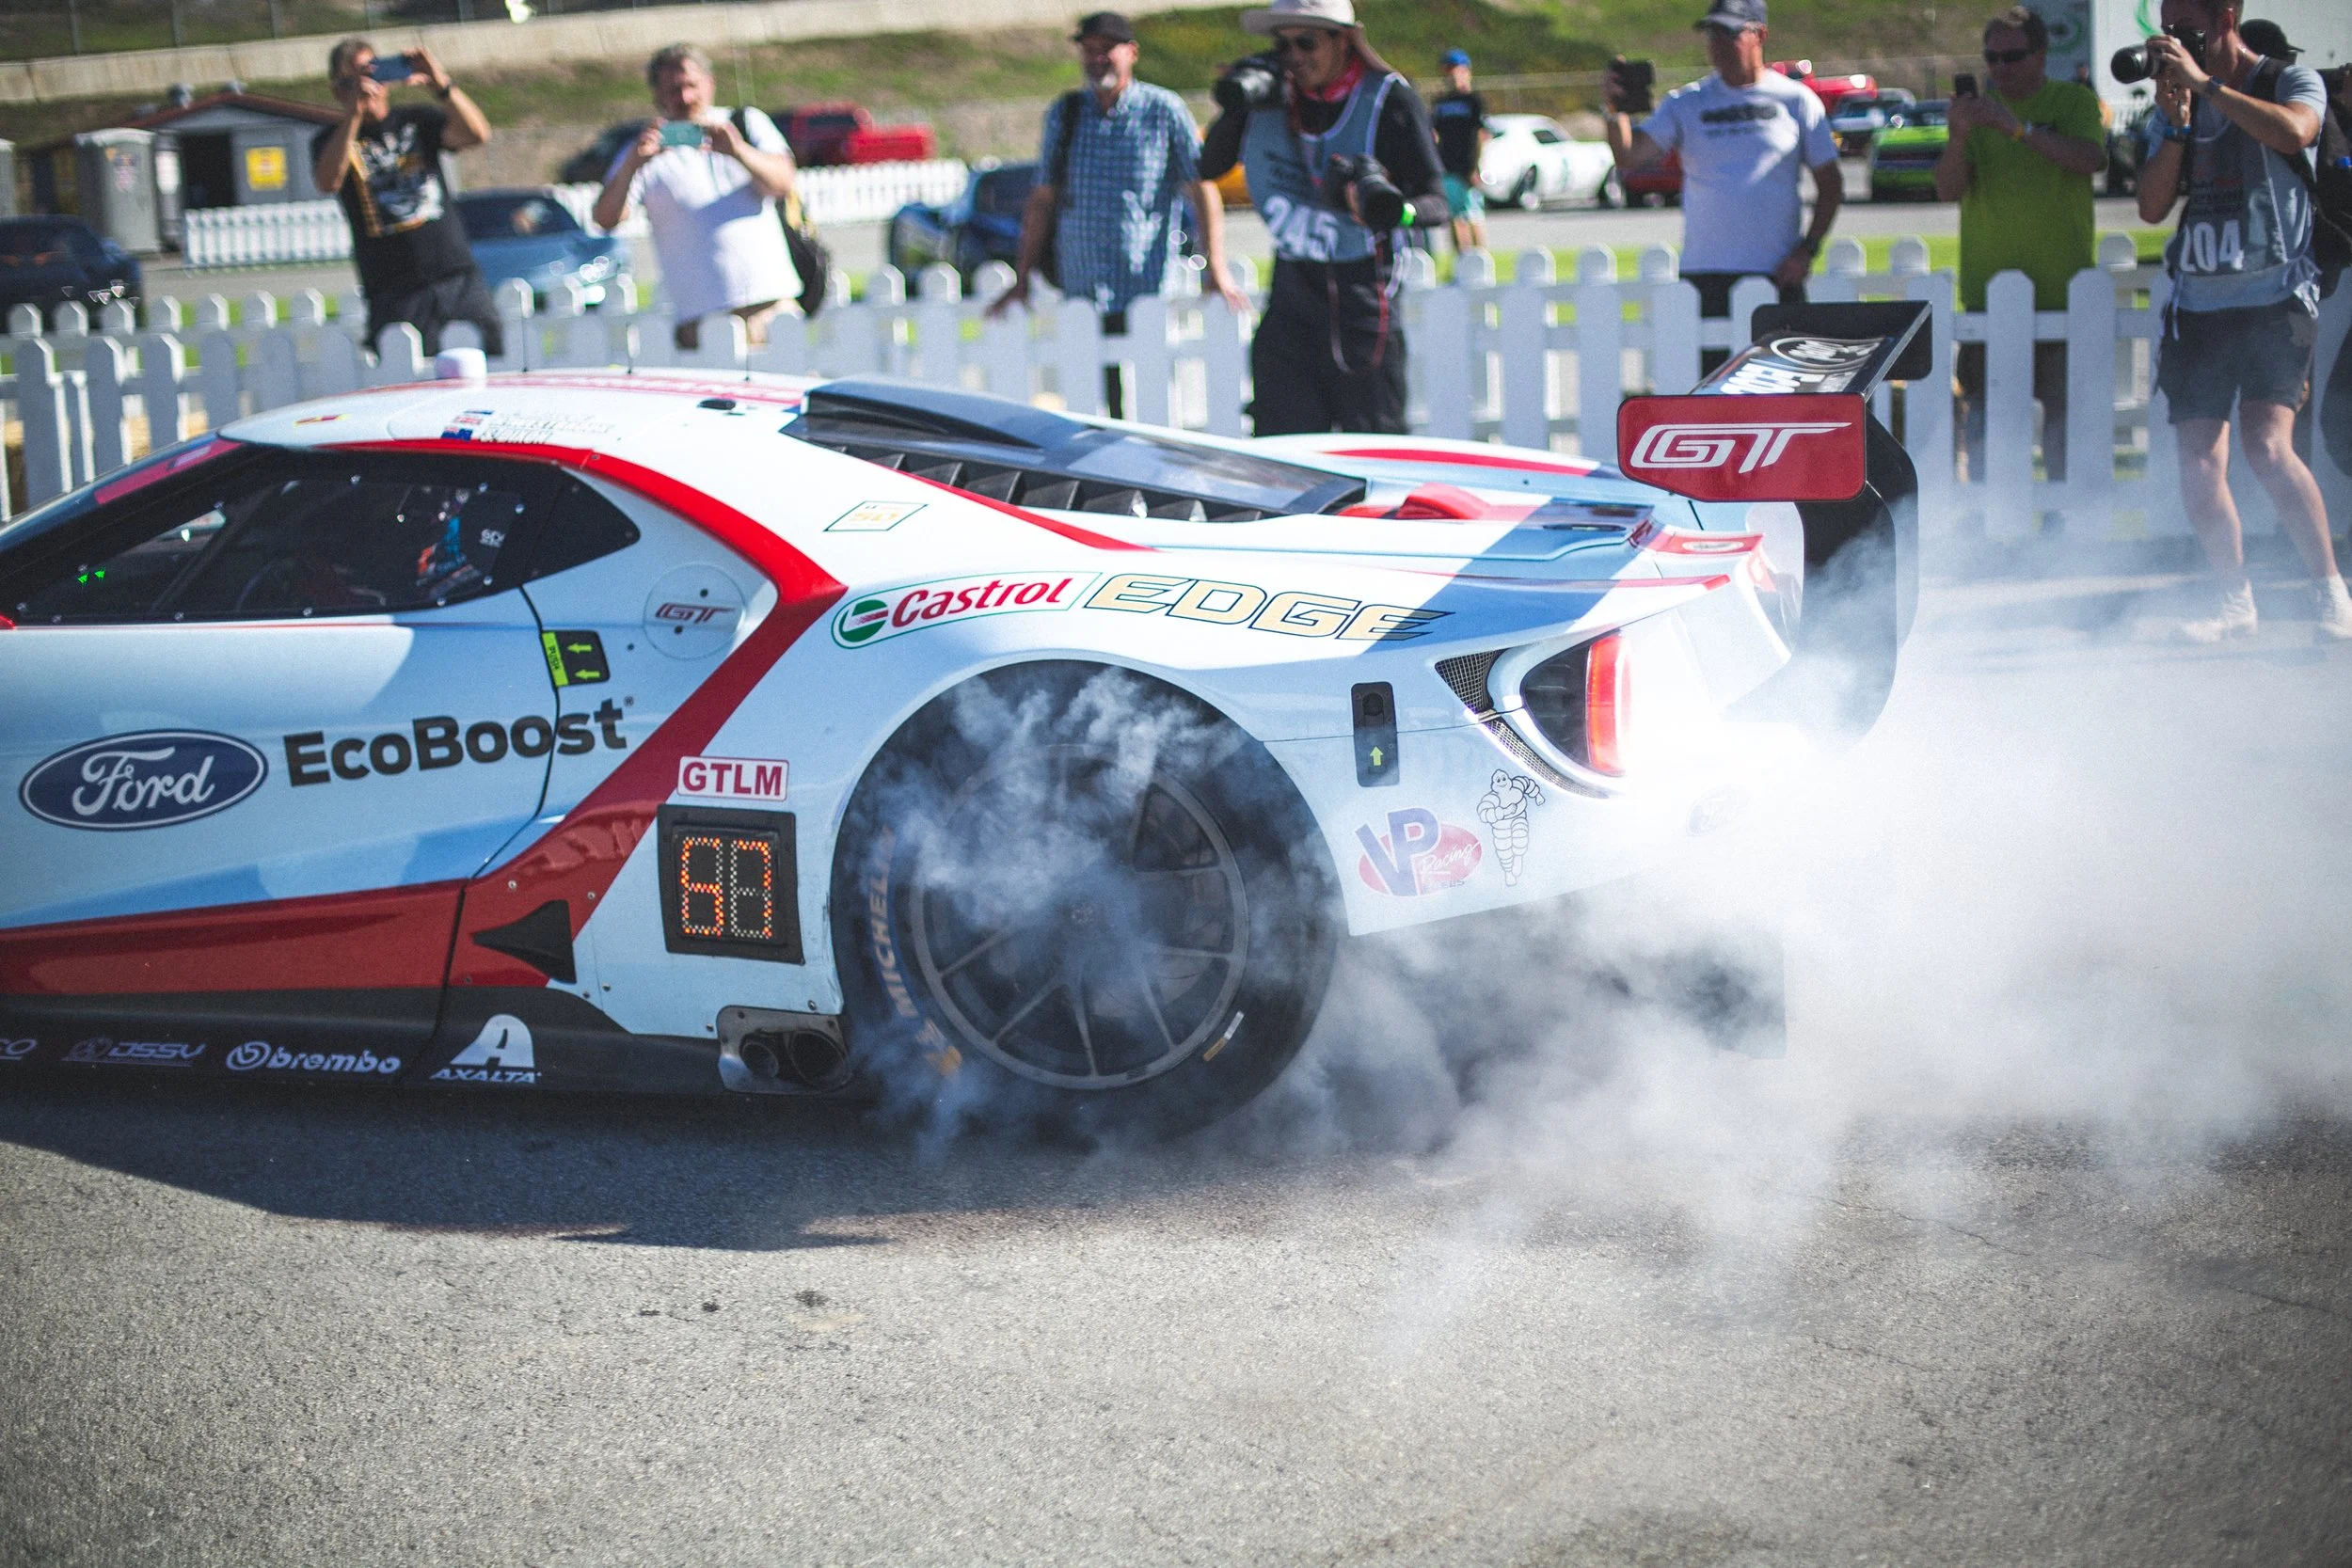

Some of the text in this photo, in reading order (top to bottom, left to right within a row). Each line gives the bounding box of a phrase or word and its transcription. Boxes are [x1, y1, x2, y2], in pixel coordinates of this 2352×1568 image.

[1263, 194, 1338, 261] 245
[1629, 422, 1852, 474] GT
[655, 602, 737, 625] GT
[892, 573, 1456, 641] Castrol EDGE
[72, 746, 215, 816] Ford
[682, 761, 783, 797] GTLM
[1355, 807, 1439, 896] VP
[267, 1046, 402, 1075] brembo
[429, 1068, 536, 1084] AXALTA
